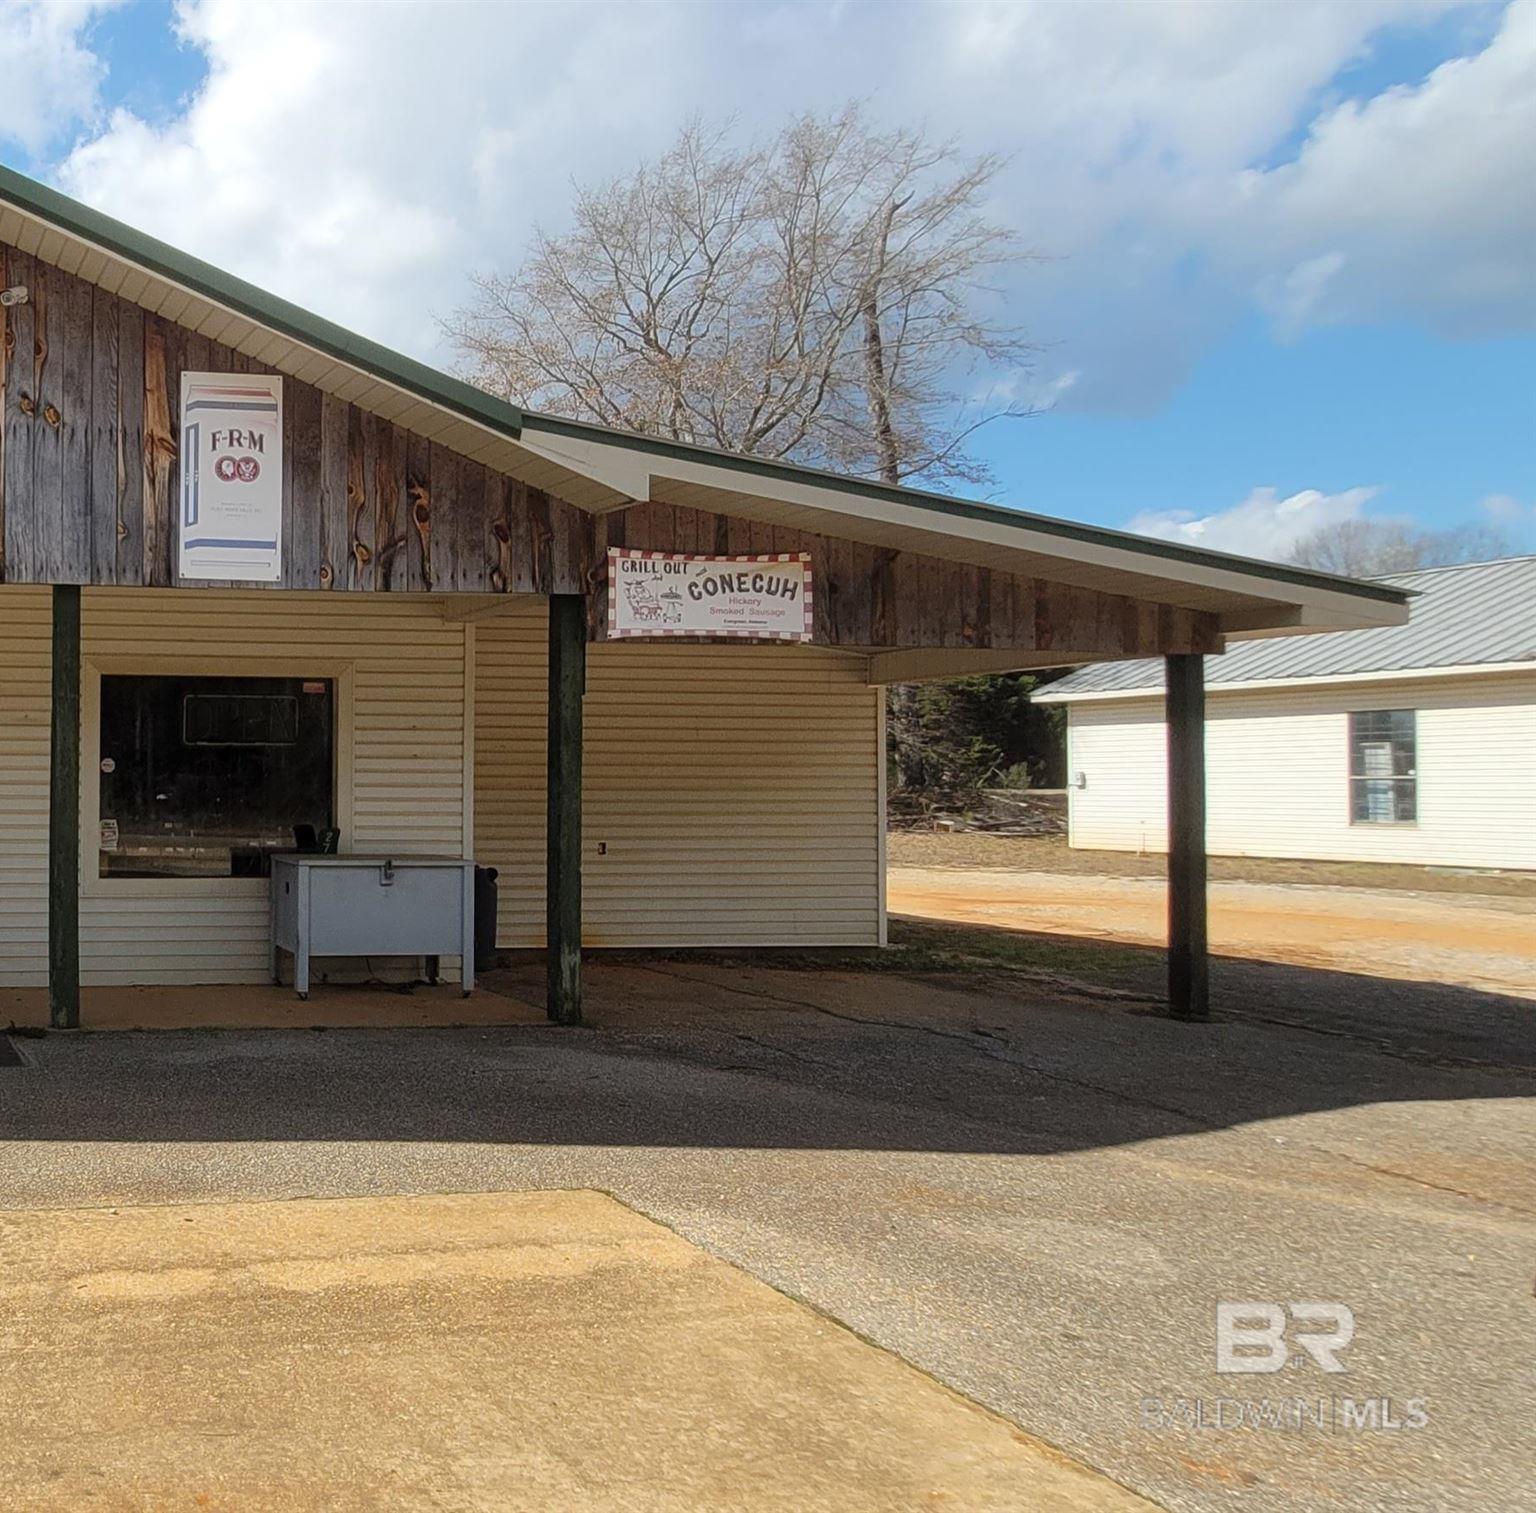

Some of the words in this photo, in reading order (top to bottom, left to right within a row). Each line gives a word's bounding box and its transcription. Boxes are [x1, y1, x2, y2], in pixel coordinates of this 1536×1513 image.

[211, 428, 265, 455] F-R-M
[621, 560, 659, 574] GRILL
[663, 562, 689, 575] OUT
[687, 573, 799, 601] CONECUH
[728, 597, 762, 606] Hickory
[709, 607, 745, 615] Smoked
[749, 607, 786, 617] Sausage
